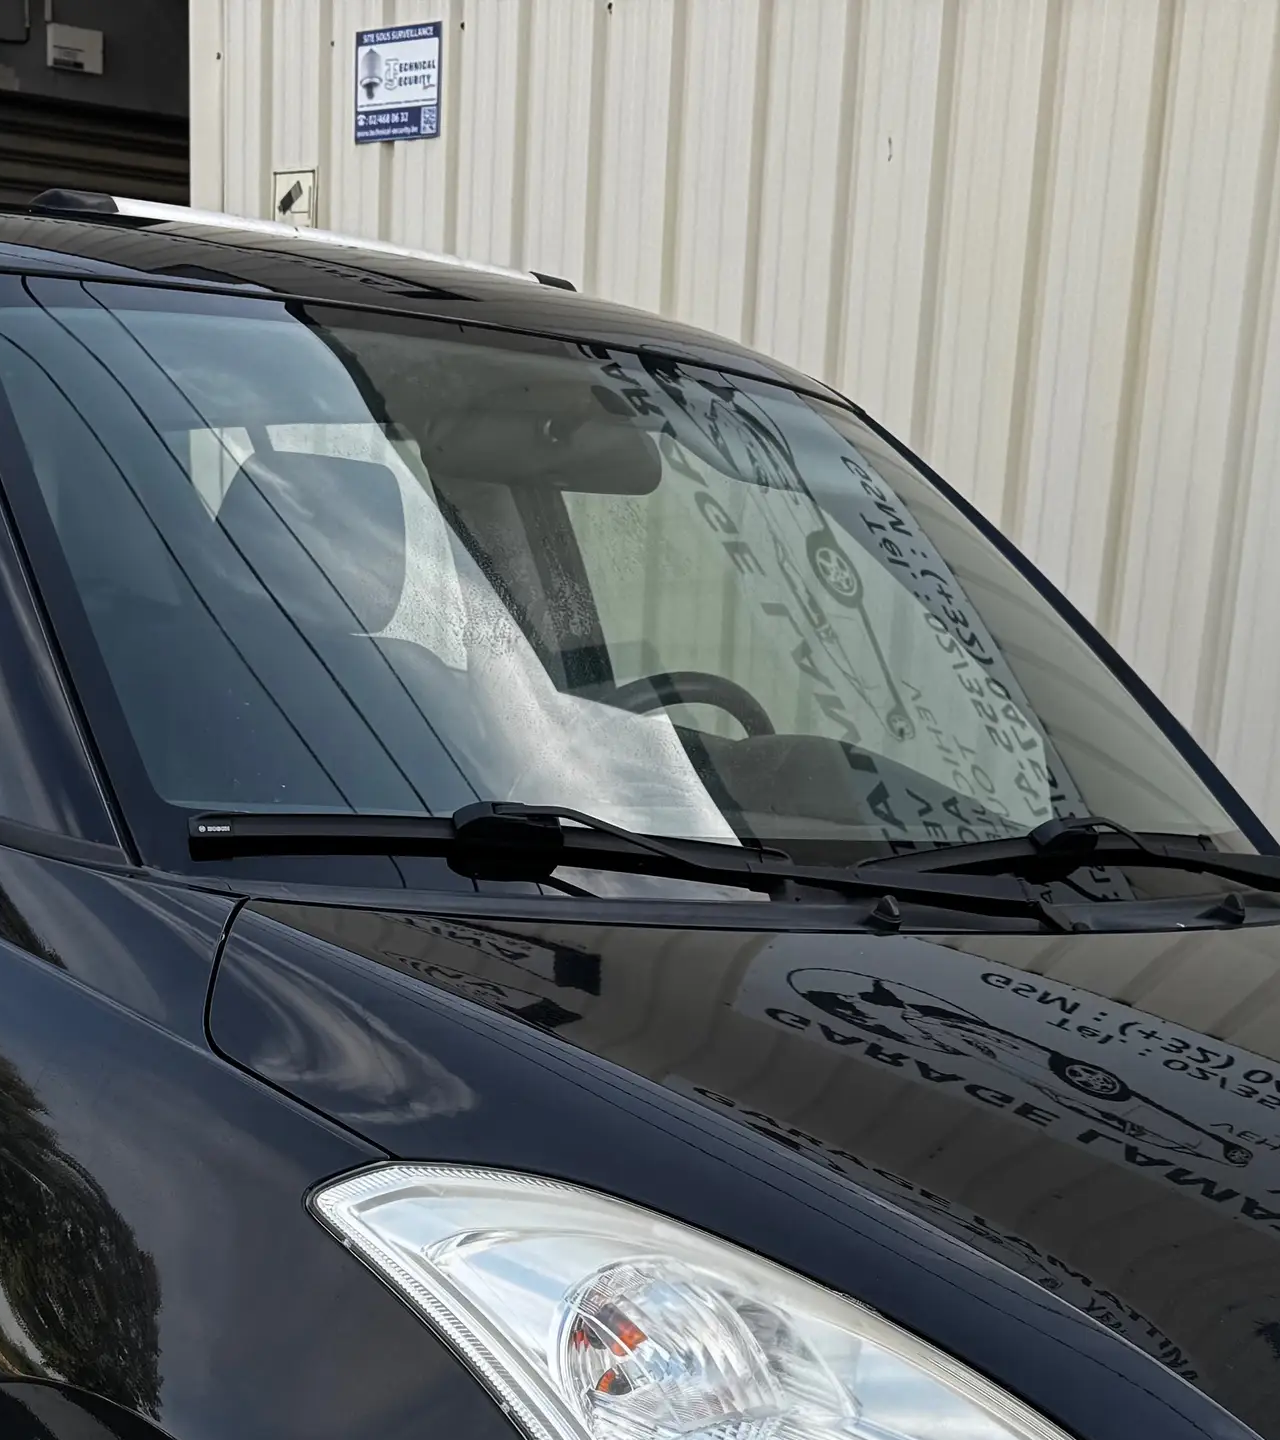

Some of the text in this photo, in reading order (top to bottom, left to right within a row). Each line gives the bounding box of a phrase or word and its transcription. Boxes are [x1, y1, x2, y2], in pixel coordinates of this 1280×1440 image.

[363, 26, 434, 44] SITE SOUS SURVEILLANCE
[385, 58, 436, 79] TECHNICAL
[385, 74, 433, 91] SECURITY
